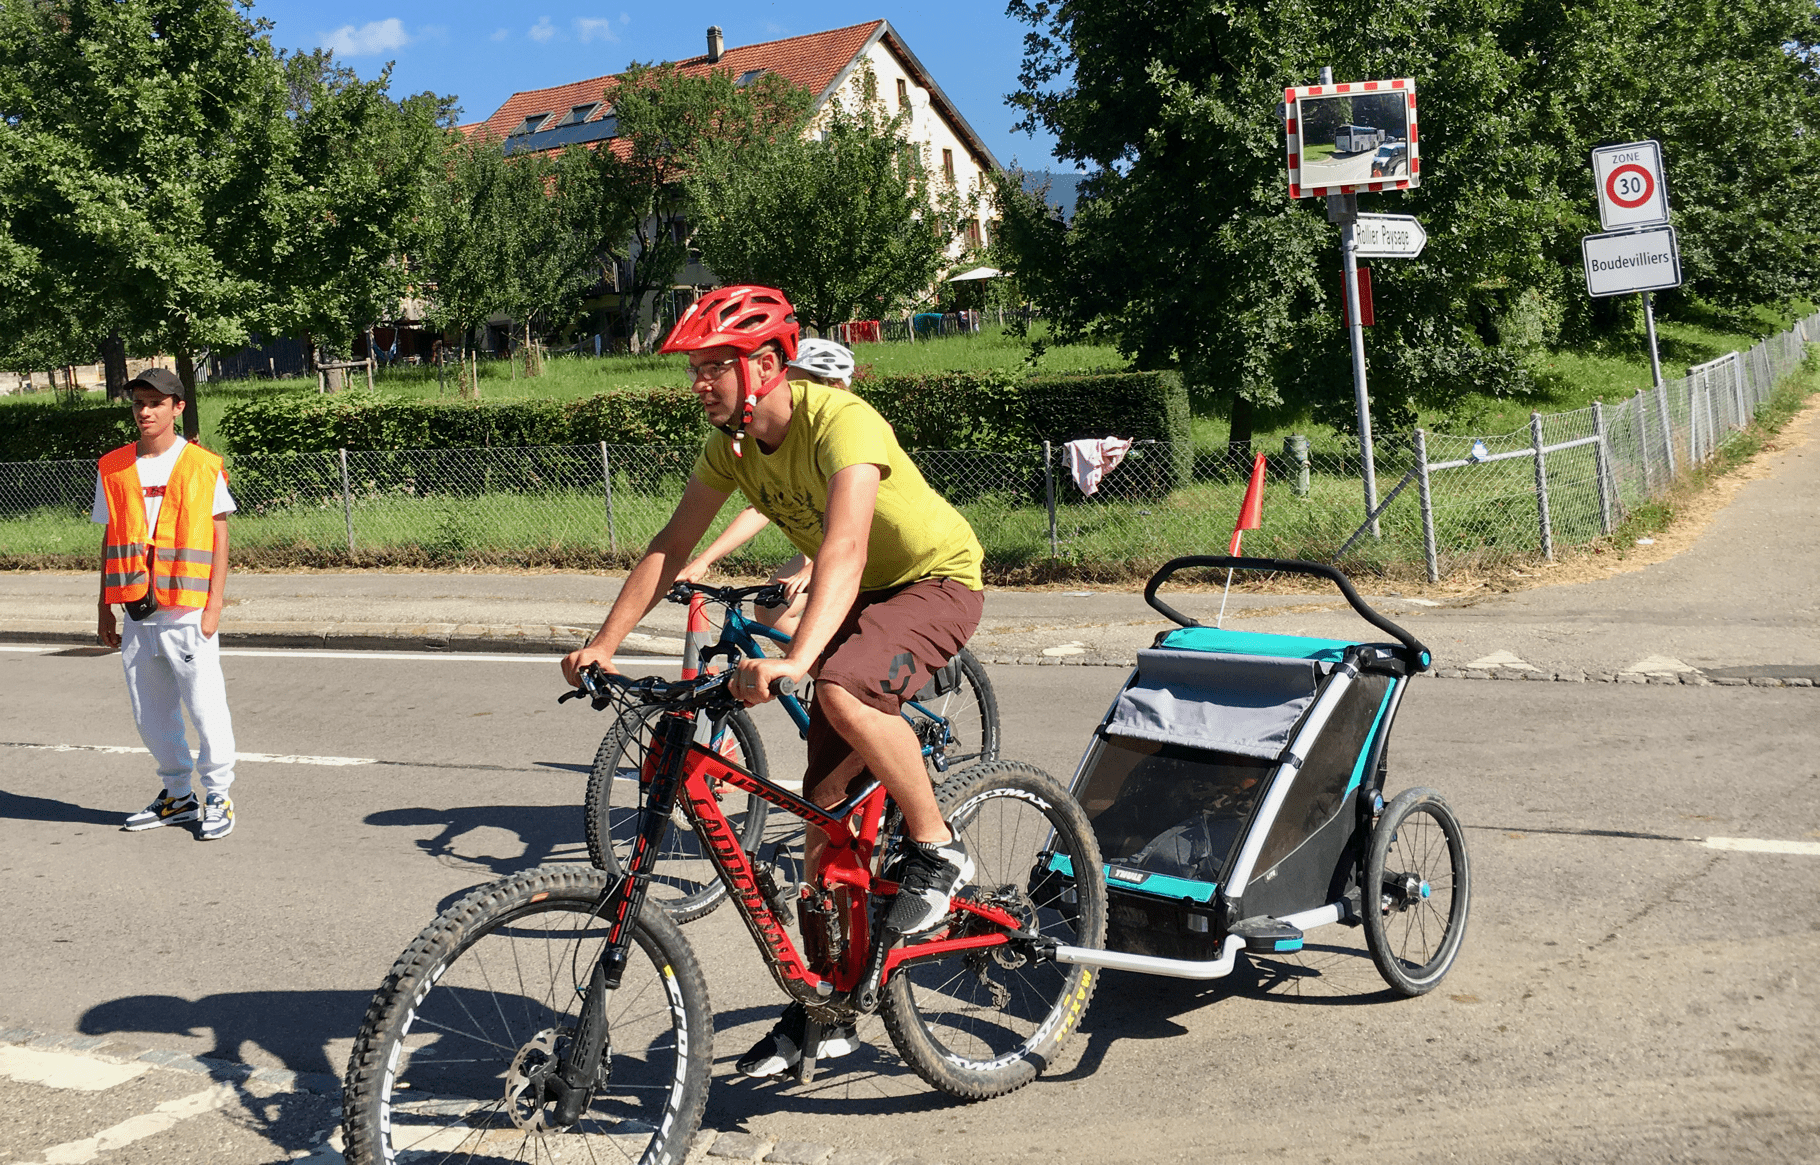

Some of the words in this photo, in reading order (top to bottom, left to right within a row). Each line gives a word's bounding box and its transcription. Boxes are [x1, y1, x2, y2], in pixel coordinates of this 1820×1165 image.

[1612, 152, 1640, 164] ZONE
[1620, 177, 1641, 195] 30
[1356, 224, 1379, 245] Rollier
[1382, 225, 1409, 250] Paysage
[1592, 252, 1669, 272] Boudevilliers
[948, 788, 1053, 823] ROSSMAX
[1115, 869, 1144, 882] THULE
[870, 947, 884, 990] SRAM
